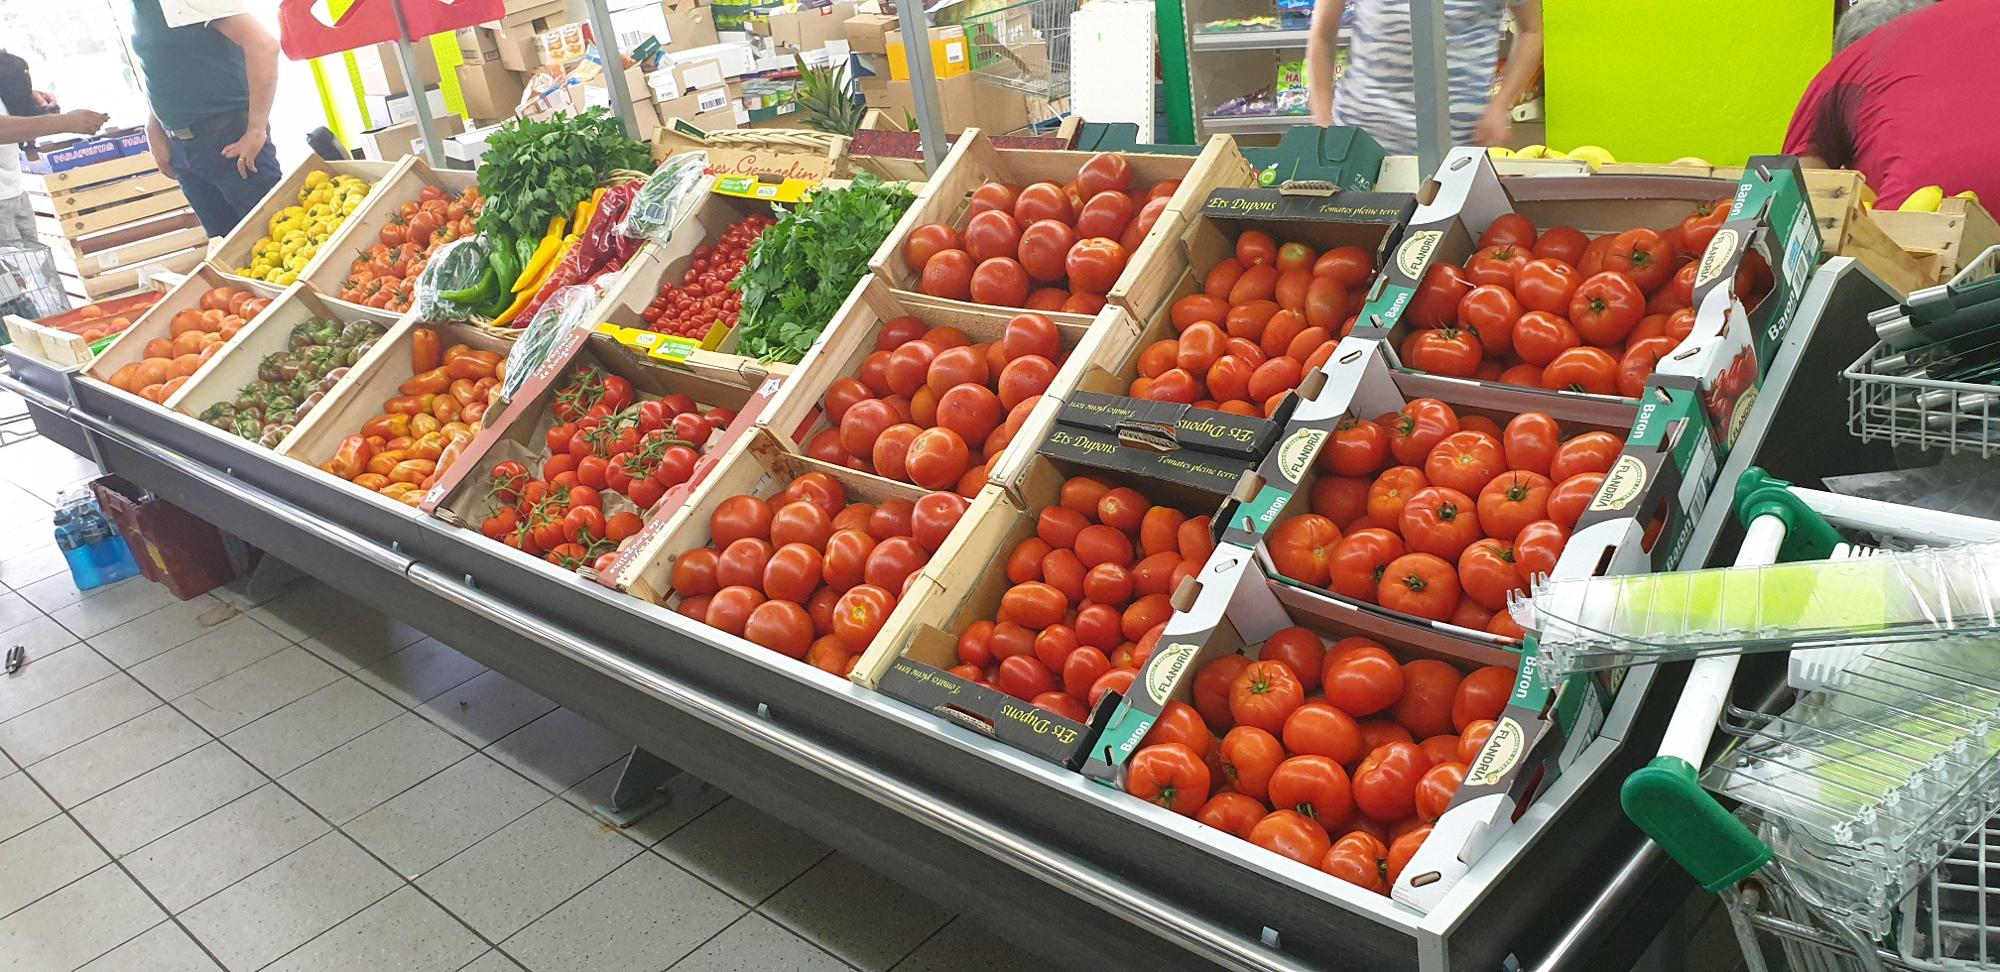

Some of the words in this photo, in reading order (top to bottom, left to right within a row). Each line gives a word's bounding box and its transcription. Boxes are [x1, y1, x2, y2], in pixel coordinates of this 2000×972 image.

[1207, 197, 1229, 210] Ets
[1231, 198, 1277, 215] Dupons
[1319, 204, 1352, 215] Tomates
[1350, 205, 1378, 217] pleine
[1379, 207, 1401, 216] terre
[1731, 183, 1753, 216] Baron
[1410, 232, 1438, 270] FLANDRIA
[1699, 235, 1725, 283] FLANDRIA
[1384, 292, 1408, 318] Baron
[1768, 290, 1796, 341] Baron
[1085, 403, 1108, 416] pleine
[1106, 406, 1136, 418] Tomates
[1632, 403, 1656, 439] Baron
[1177, 417, 1226, 439] Dupons
[1229, 428, 1255, 442] Ets
[1050, 431, 1073, 444] Ets
[1074, 435, 1118, 454] Dupons
[1291, 431, 1323, 473] FLANDRIA
[1158, 454, 1191, 470] Tomates
[1188, 462, 1217, 476] pleine
[1217, 467, 1239, 480] terre
[1596, 464, 1630, 508] FLANDRIA
[1260, 495, 1287, 522] Baron
[1666, 520, 1695, 572] Baron
[894, 663, 913, 676] terre
[912, 670, 936, 684] pleine
[1158, 647, 1193, 693] FLANDRIA
[1516, 656, 1537, 699] Baron
[931, 677, 961, 695] Tomates
[1001, 704, 1051, 734] Dupons
[1052, 724, 1079, 744] Ets
[1120, 721, 1150, 752] Baron
[1471, 729, 1510, 781] FLANDRIA
